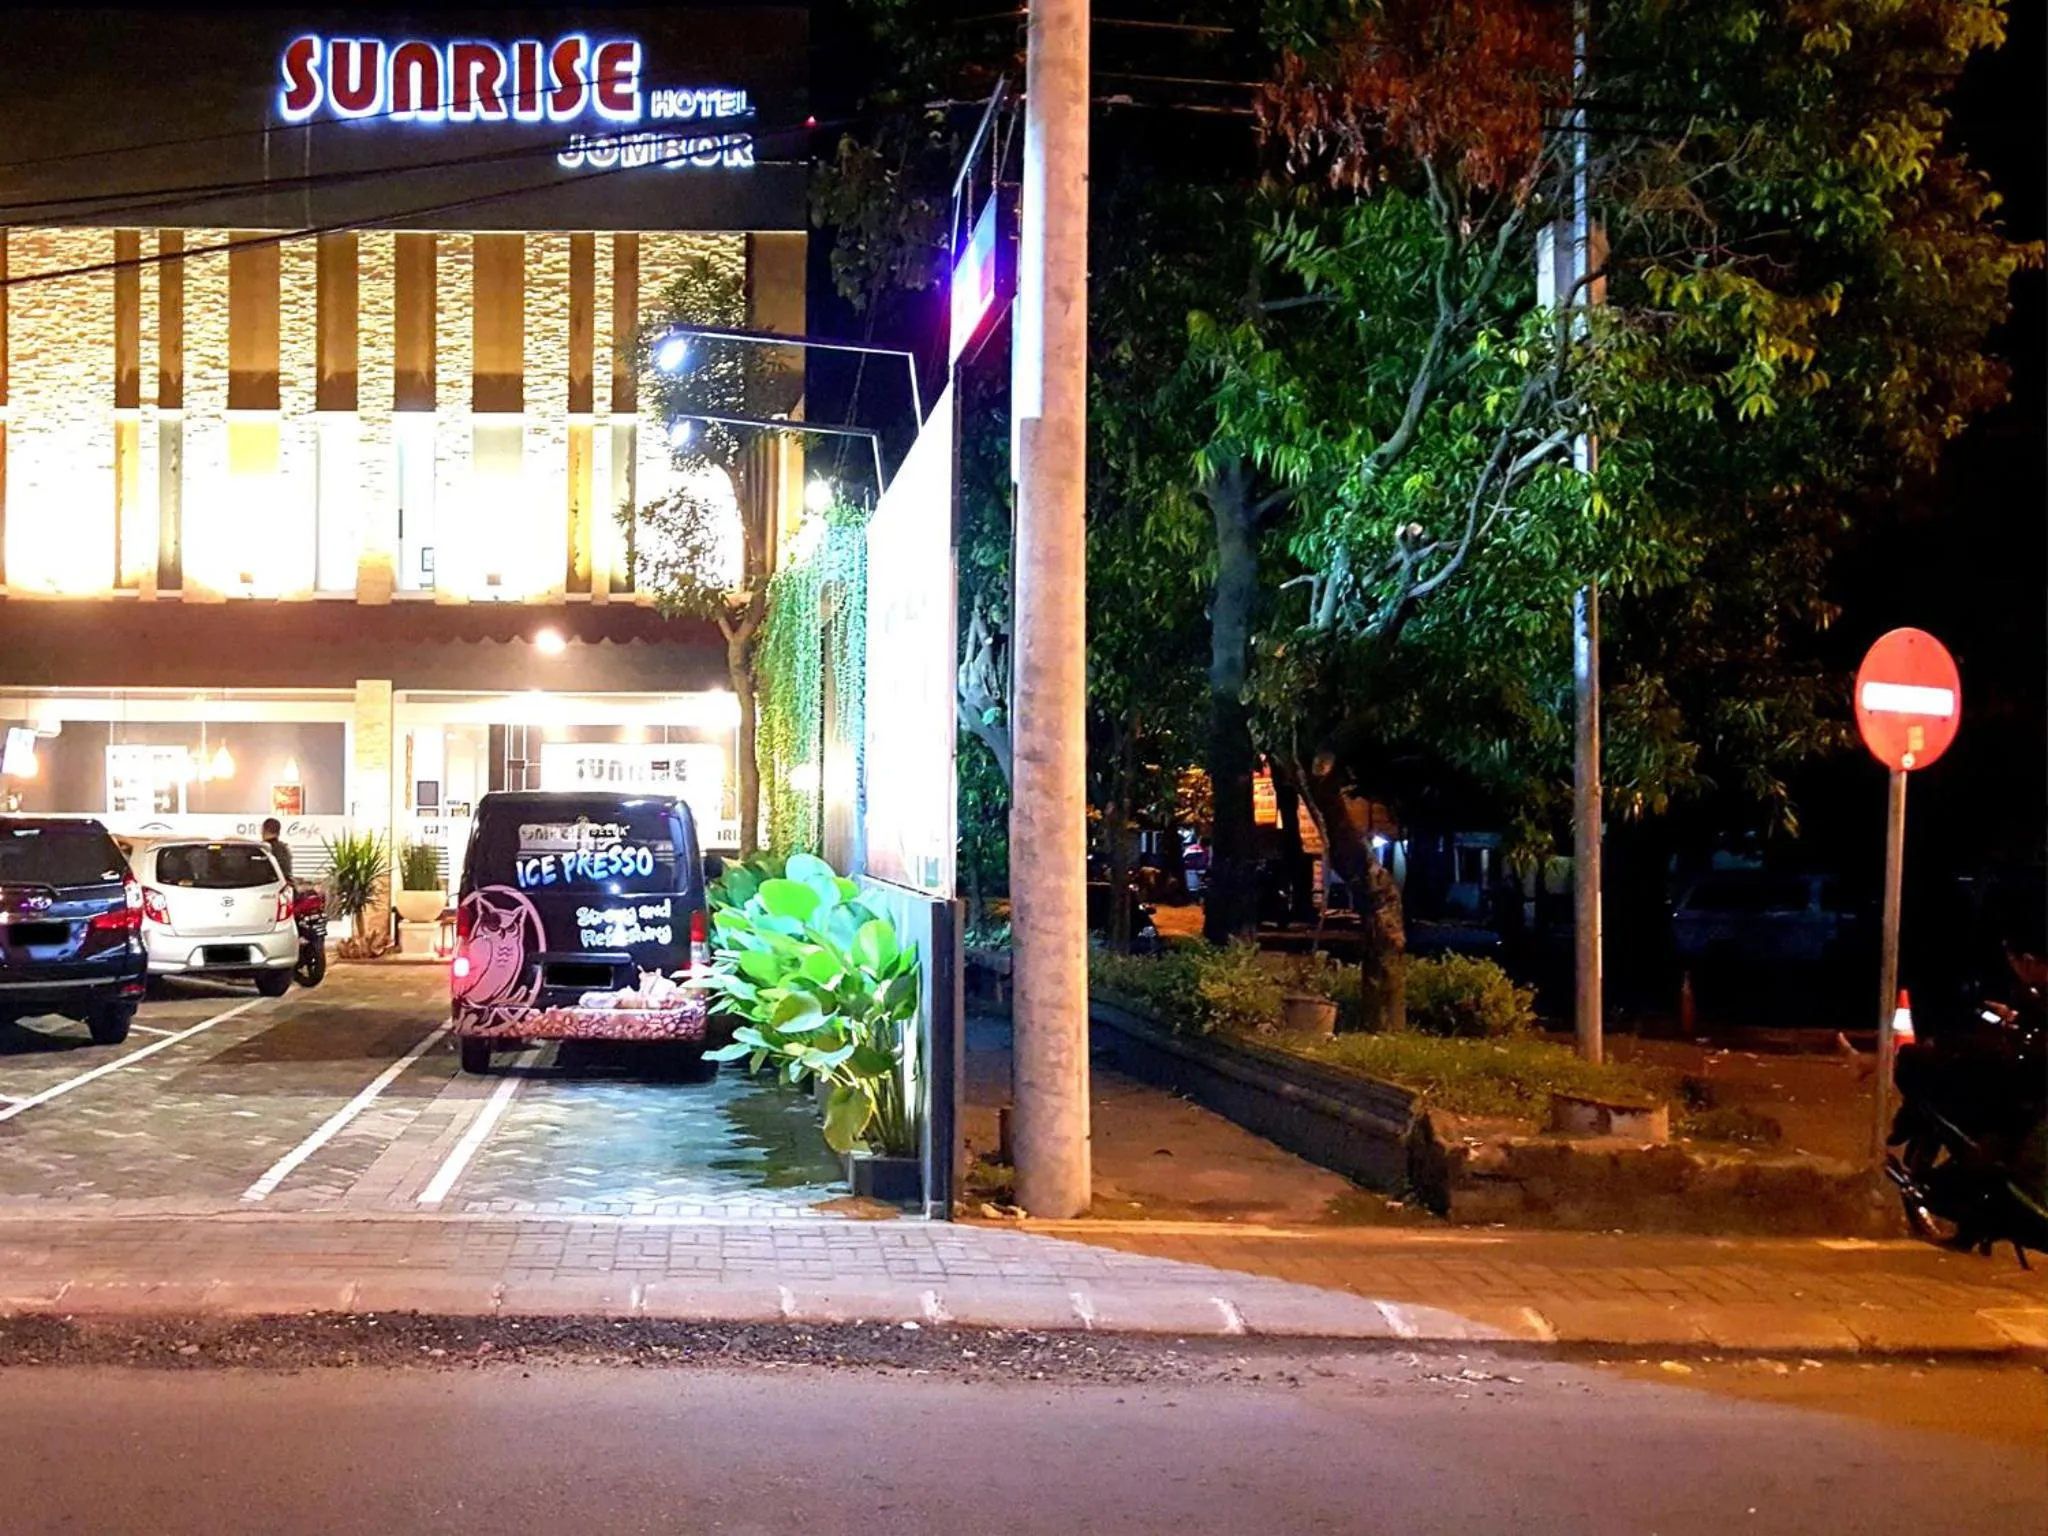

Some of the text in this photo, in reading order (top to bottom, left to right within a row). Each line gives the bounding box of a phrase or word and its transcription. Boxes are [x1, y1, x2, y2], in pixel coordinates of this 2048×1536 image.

[281, 34, 754, 124] SUNRISE HOTEL
[557, 133, 755, 168] JOMBOR
[516, 845, 654, 888] ICE PRESSO
[576, 898, 671, 927] Strg and
[580, 923, 673, 948] Refshing
